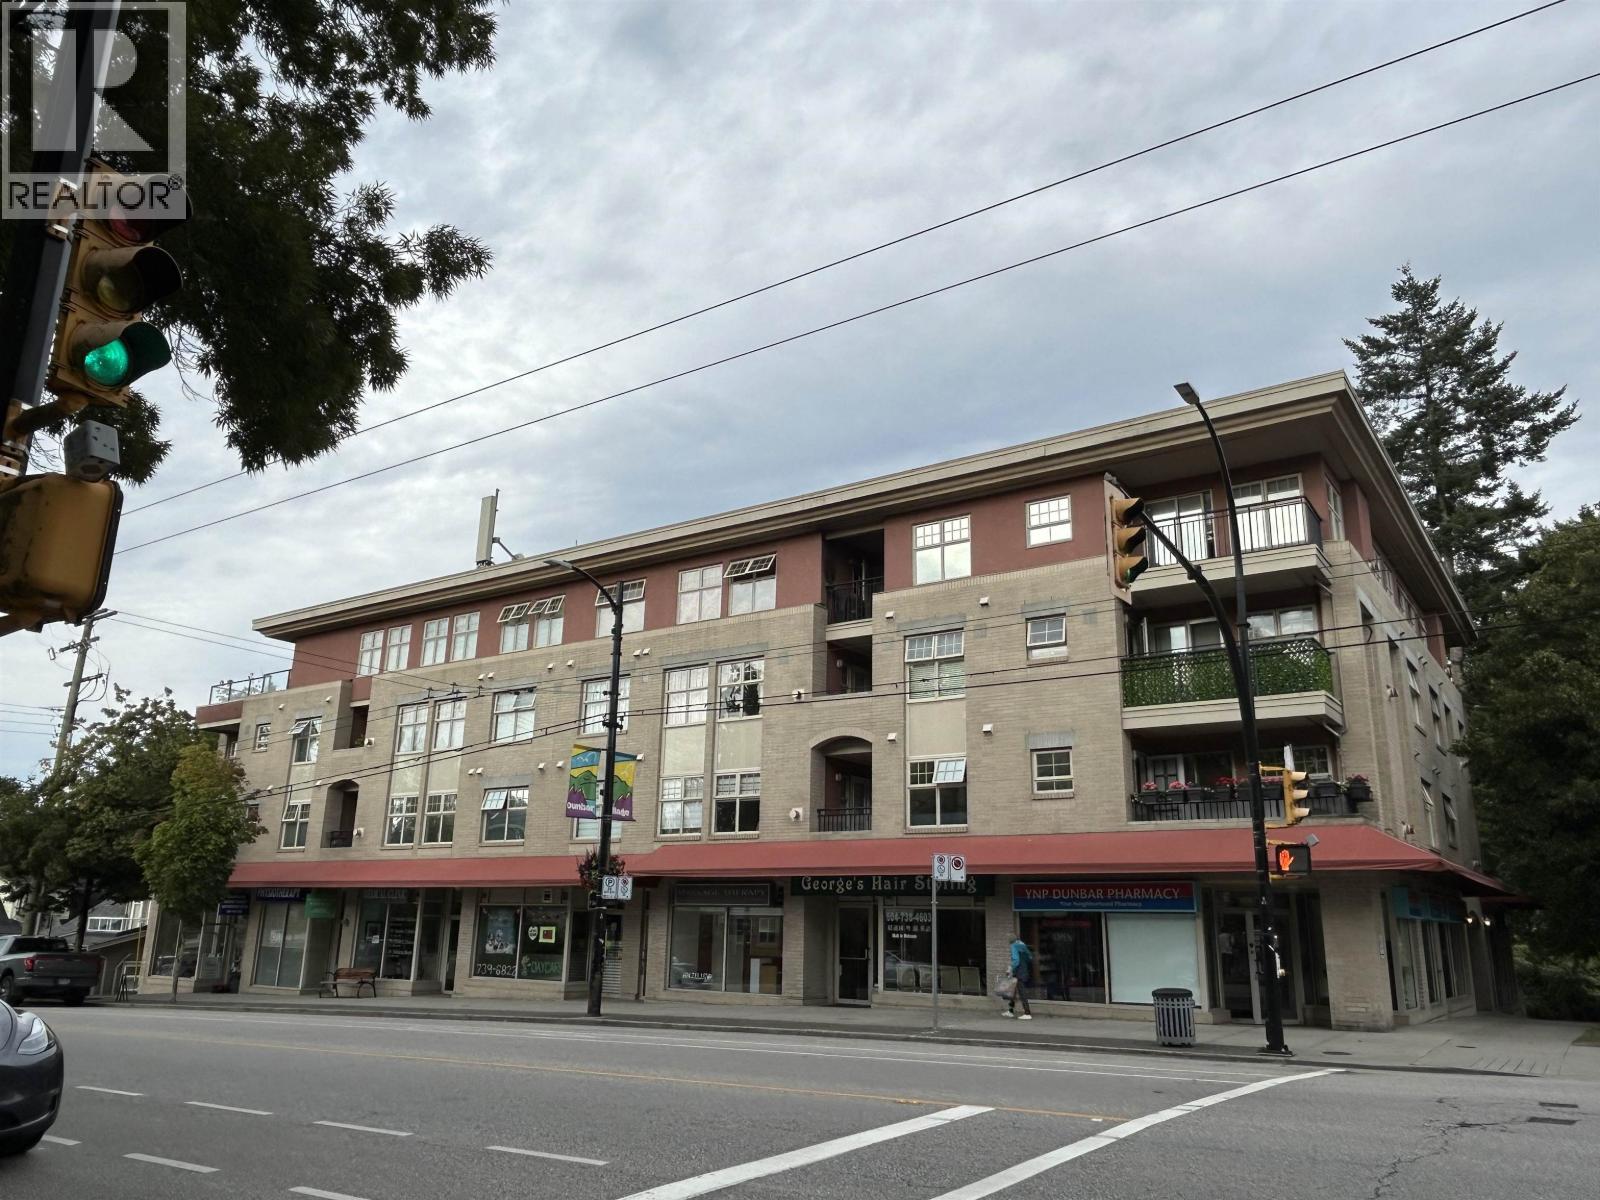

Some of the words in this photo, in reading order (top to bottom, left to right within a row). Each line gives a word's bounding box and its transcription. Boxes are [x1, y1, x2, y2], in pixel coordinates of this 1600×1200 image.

[612, 806, 630, 817] llage
[801, 876, 864, 894] George's
[872, 877, 907, 891] Hair
[914, 876, 977, 893] Styling
[1025, 888, 1049, 899] YNP
[1053, 888, 1104, 899] DUNBAR
[1107, 888, 1180, 899] PHARMACY
[476, 963, 517, 976] 739-6822
[531, 960, 561, 974] DAYCAR
